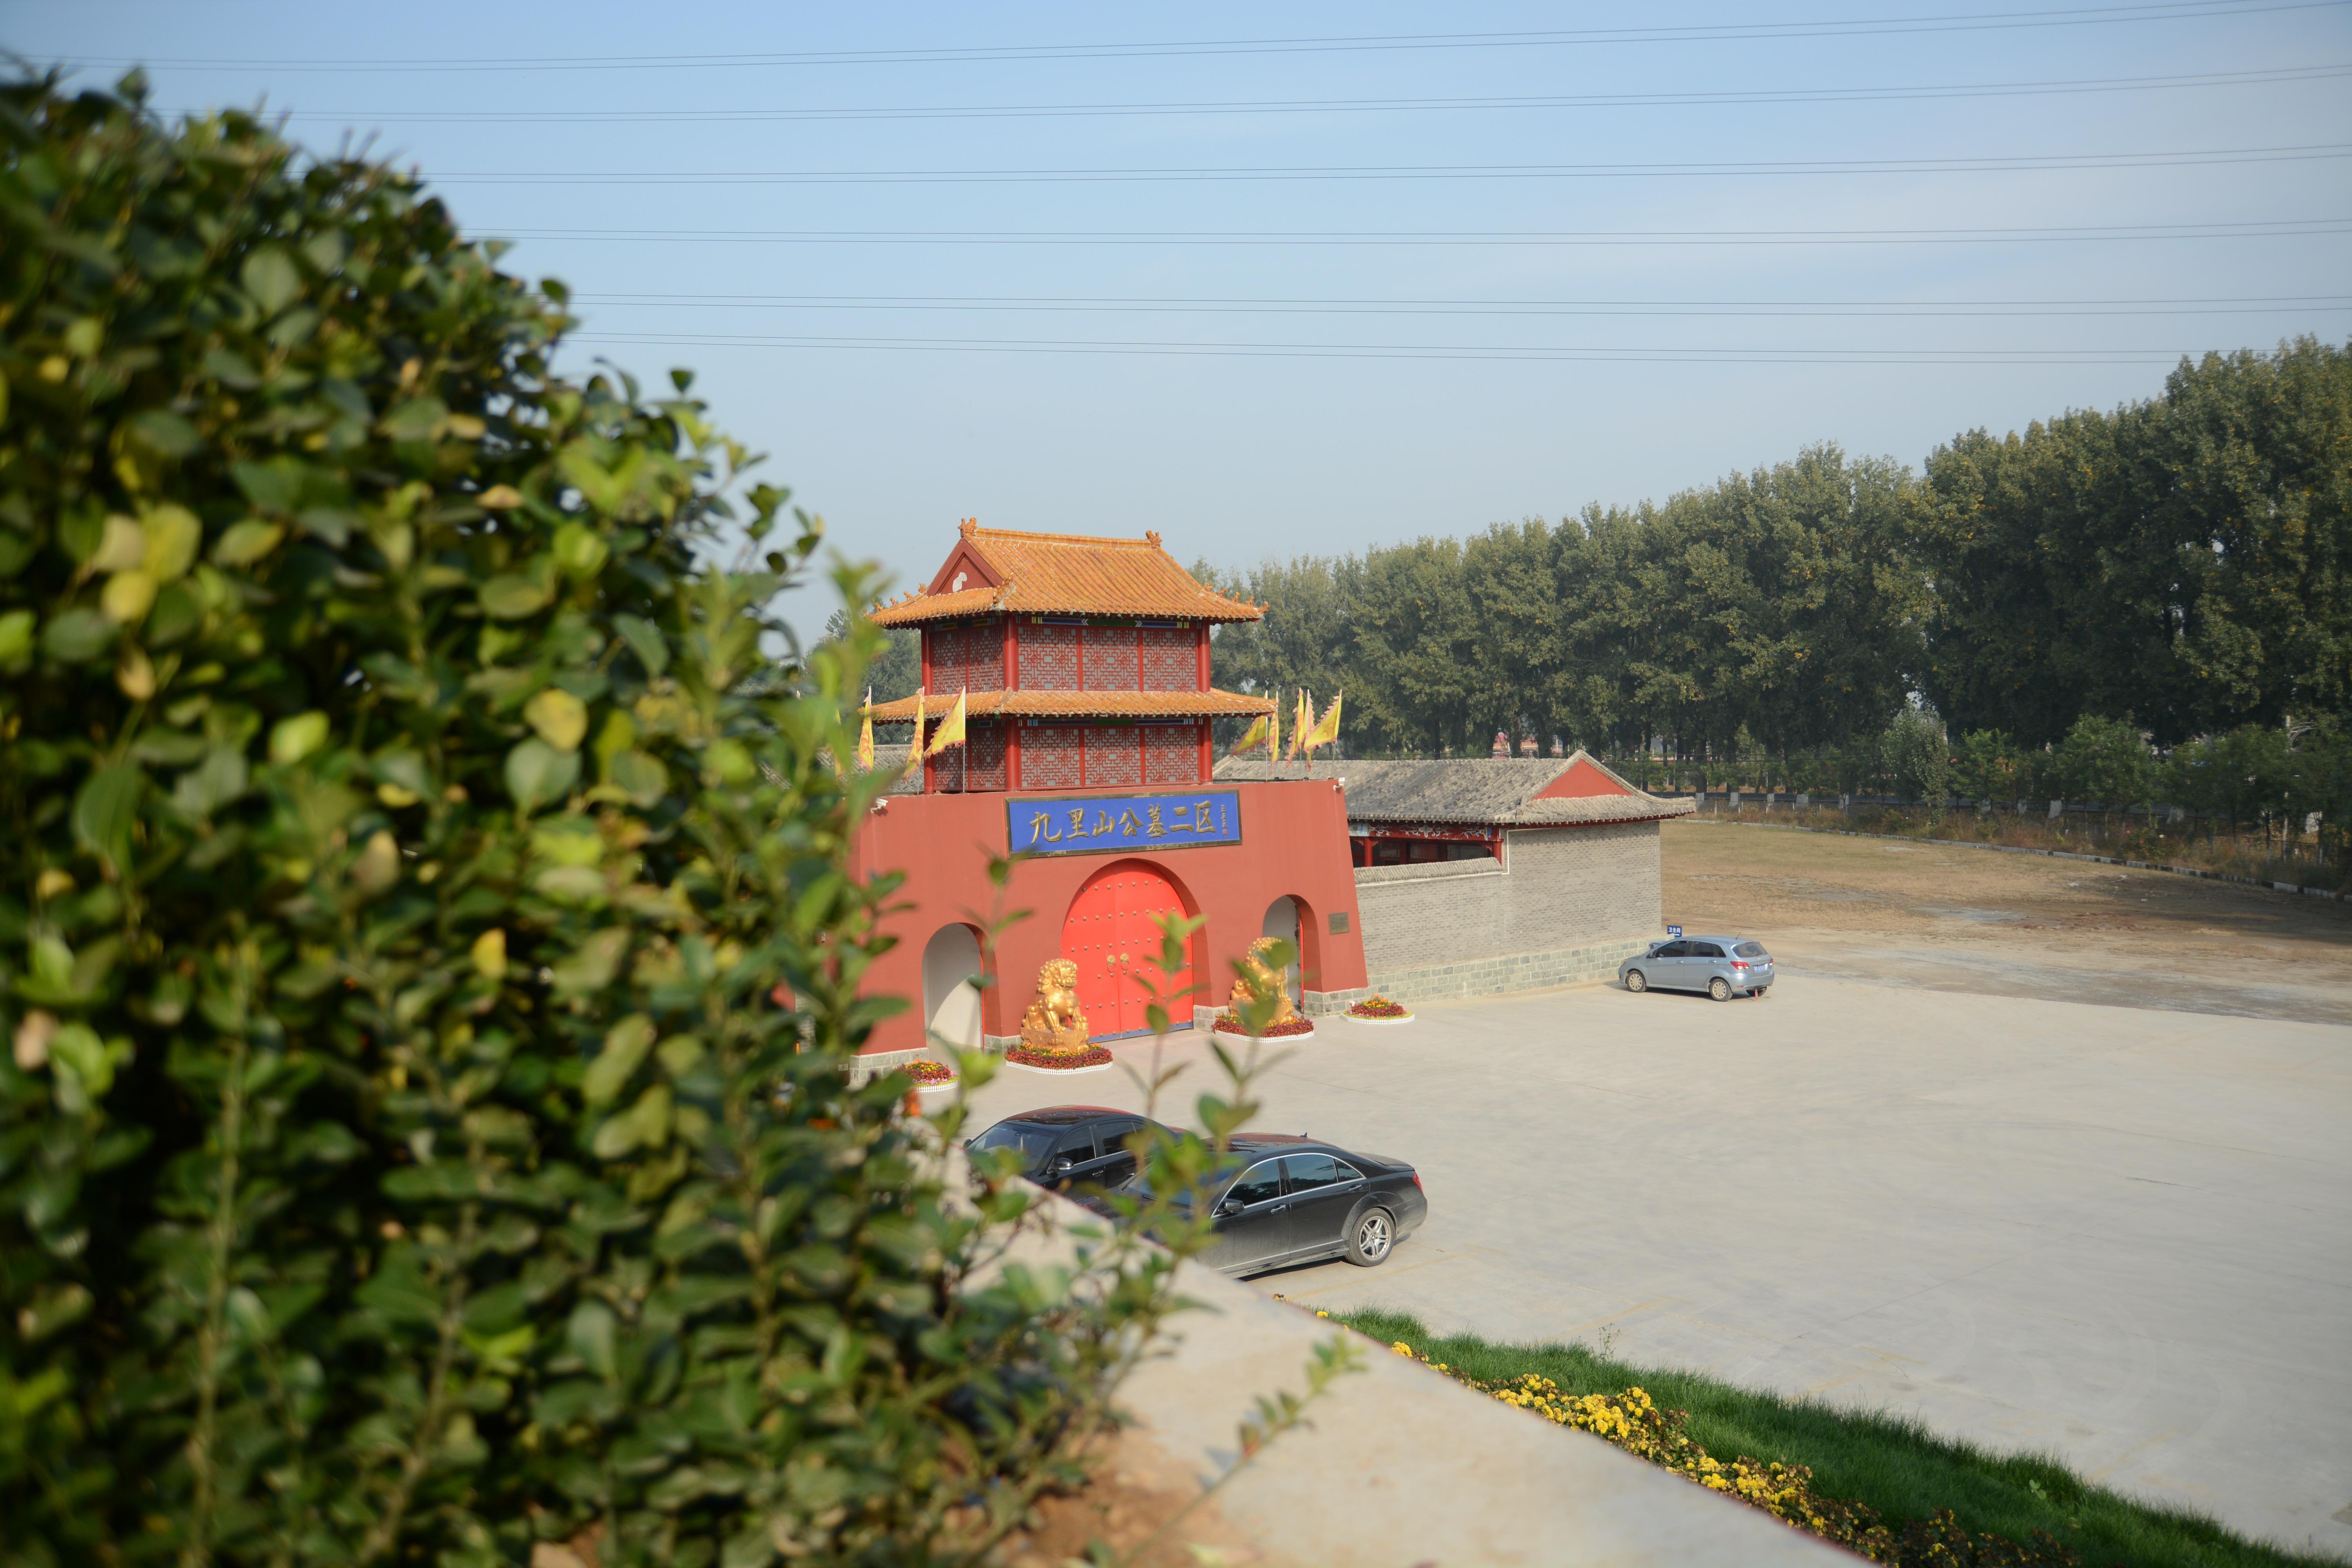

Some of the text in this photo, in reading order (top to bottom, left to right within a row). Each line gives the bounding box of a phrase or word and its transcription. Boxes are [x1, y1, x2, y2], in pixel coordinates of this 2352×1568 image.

[1030, 801, 1215, 844] 九里山公墓二区
